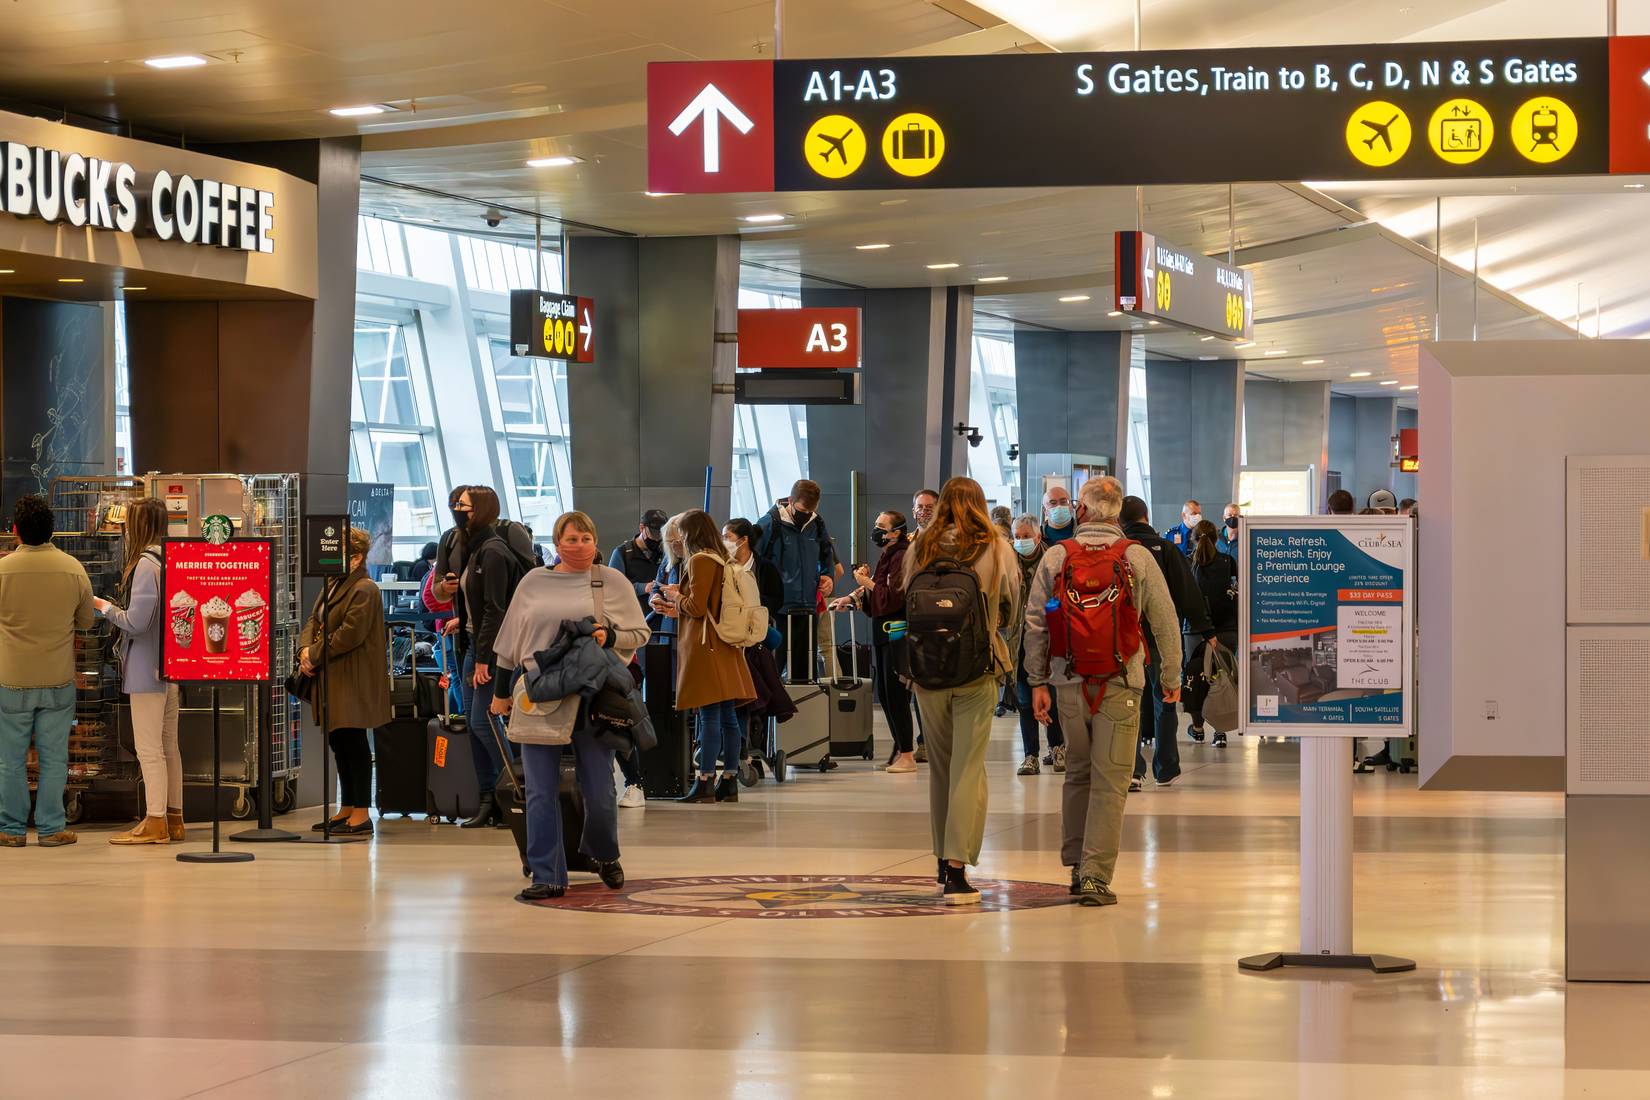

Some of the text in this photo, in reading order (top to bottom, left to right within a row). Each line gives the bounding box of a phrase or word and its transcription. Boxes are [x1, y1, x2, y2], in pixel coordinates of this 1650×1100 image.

[1076, 59, 1578, 96] S Gates, Train to B, C, D, N & S Gates
[804, 69, 897, 101] A1-A3
[0, 142, 275, 254] BUCKS COFFEE
[540, 296, 575, 319] Baggage Claim
[805, 323, 848, 352] A3
[375, 488, 389, 496] DELTA
[351, 500, 367, 517] CAN
[1256, 536, 1328, 546] Relax. Refresh.
[1256, 549, 1332, 560] Replenish. Enjoy
[175, 561, 260, 570] MERRIER TOGETHER
[1257, 561, 1345, 573] a Premium Lounge
[1256, 573, 1310, 584] Experience
[1362, 591, 1375, 599] DAY
[1376, 591, 1392, 599] PASS
